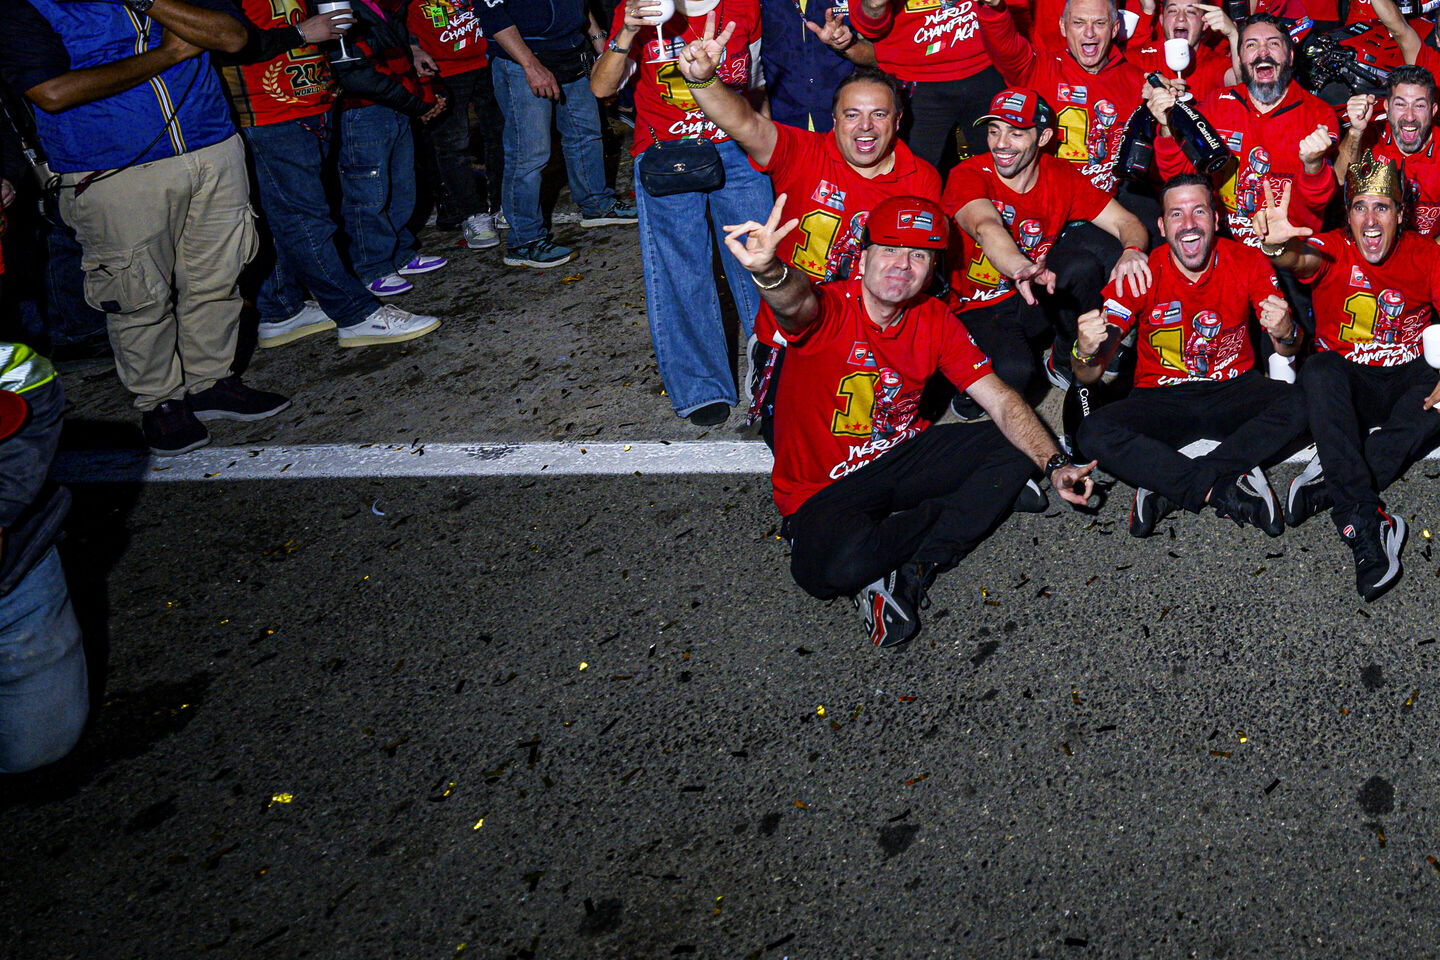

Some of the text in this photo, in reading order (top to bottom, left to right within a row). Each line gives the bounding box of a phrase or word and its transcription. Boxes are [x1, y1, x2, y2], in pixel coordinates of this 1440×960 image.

[1176, 100, 1221, 151] Contadi Castaldi
[1079, 388, 1090, 417] Conta
